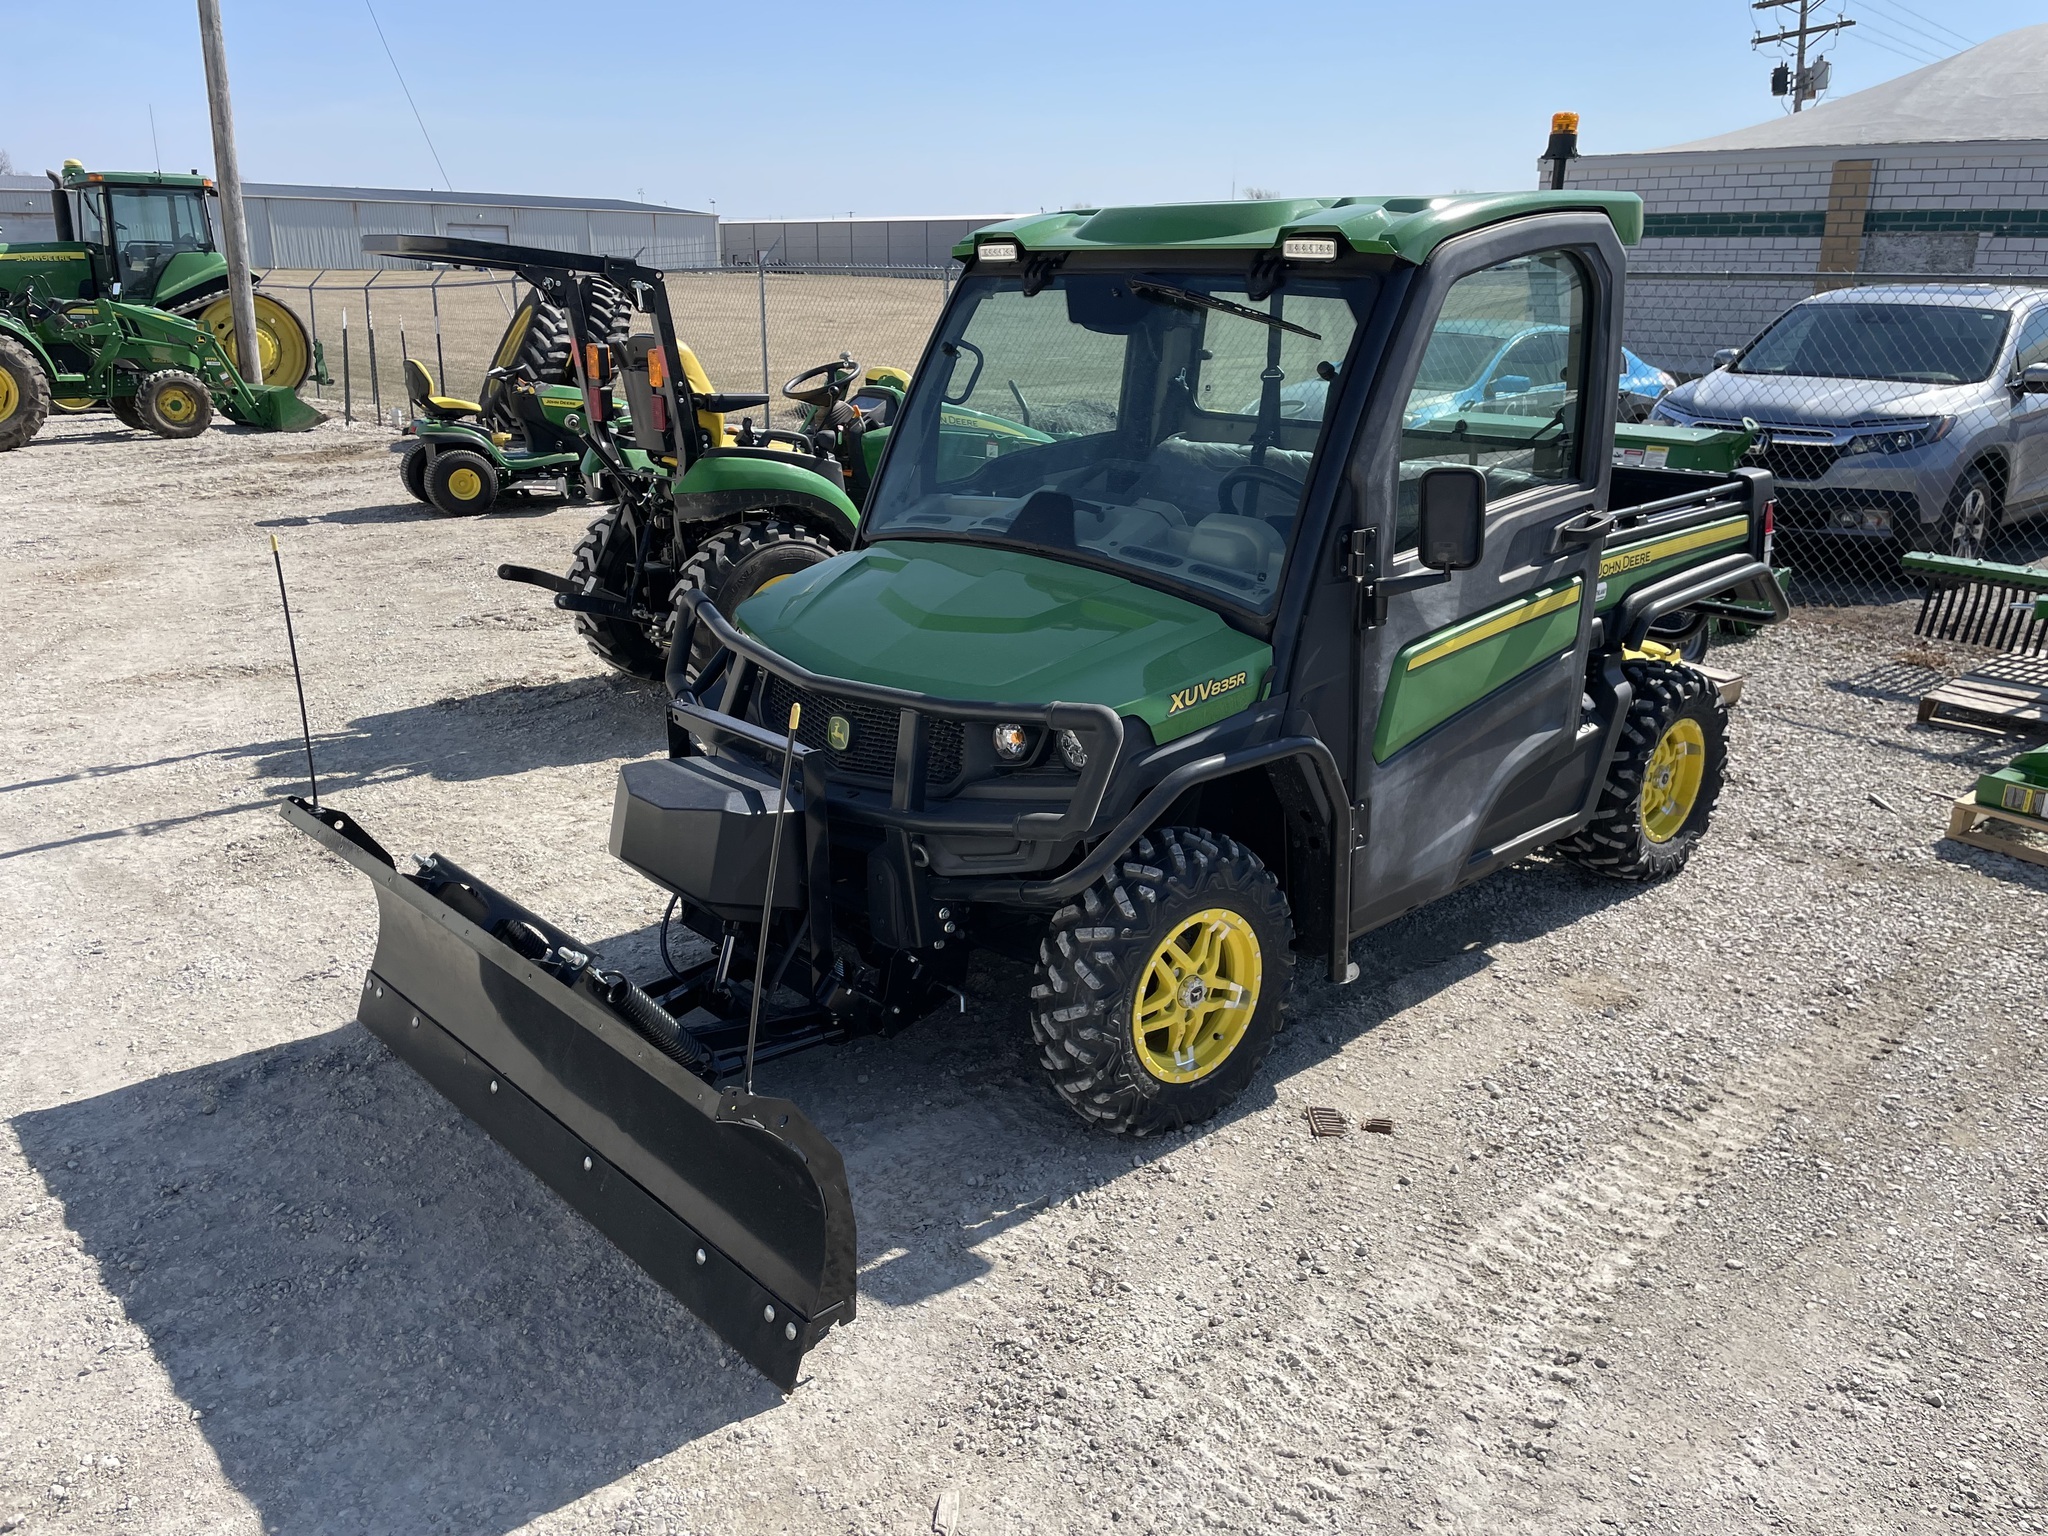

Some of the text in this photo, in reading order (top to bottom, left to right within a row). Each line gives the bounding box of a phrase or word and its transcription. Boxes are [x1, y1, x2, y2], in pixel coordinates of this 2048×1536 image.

[16, 254, 71, 262] JOHN DEERE
[948, 415, 978, 427] DEERE
[1599, 551, 1651, 577] JOHN DEERE
